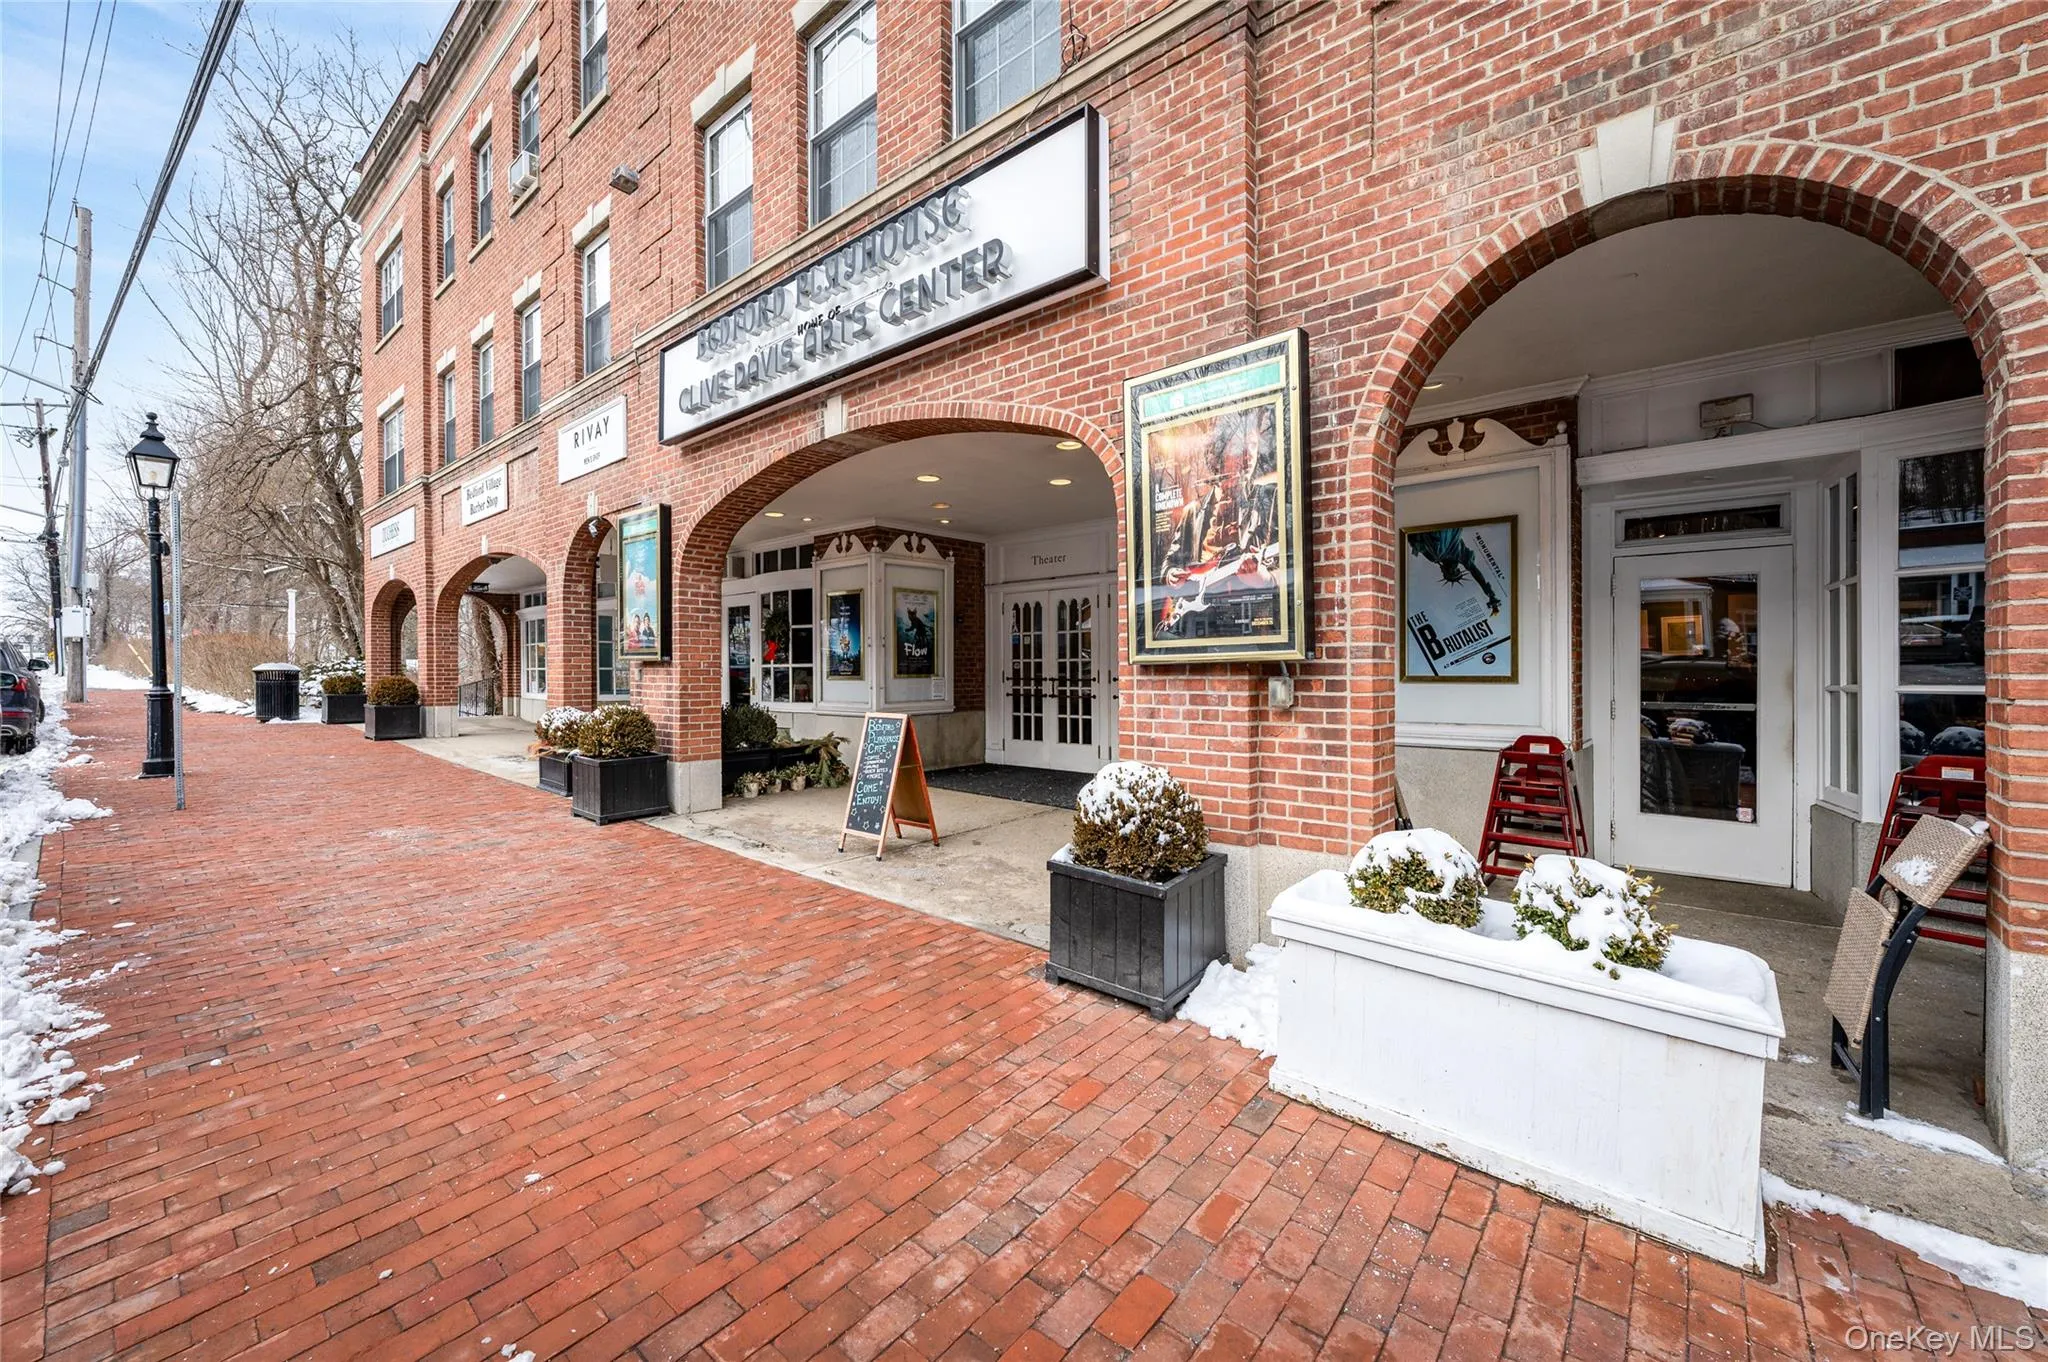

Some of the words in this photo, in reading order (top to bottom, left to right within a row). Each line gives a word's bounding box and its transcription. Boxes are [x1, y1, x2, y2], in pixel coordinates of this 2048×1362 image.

[697, 286, 793, 362] BEDFORD
[796, 185, 971, 312] PLAYHOUSE
[679, 369, 737, 415] CLIVE
[735, 337, 800, 392] DAVIS
[803, 301, 877, 363] ARTS
[879, 238, 1013, 327] CENTER
[797, 314, 824, 336] HOME
[827, 305, 842, 321] OF
[574, 415, 610, 449] RIVAY
[1031, 554, 1067, 566] Theater
[1410, 610, 1429, 628] THE
[904, 643, 928, 657] Flow
[1417, 619, 1494, 661] BRUTALIST
[856, 781, 878, 794] COME
